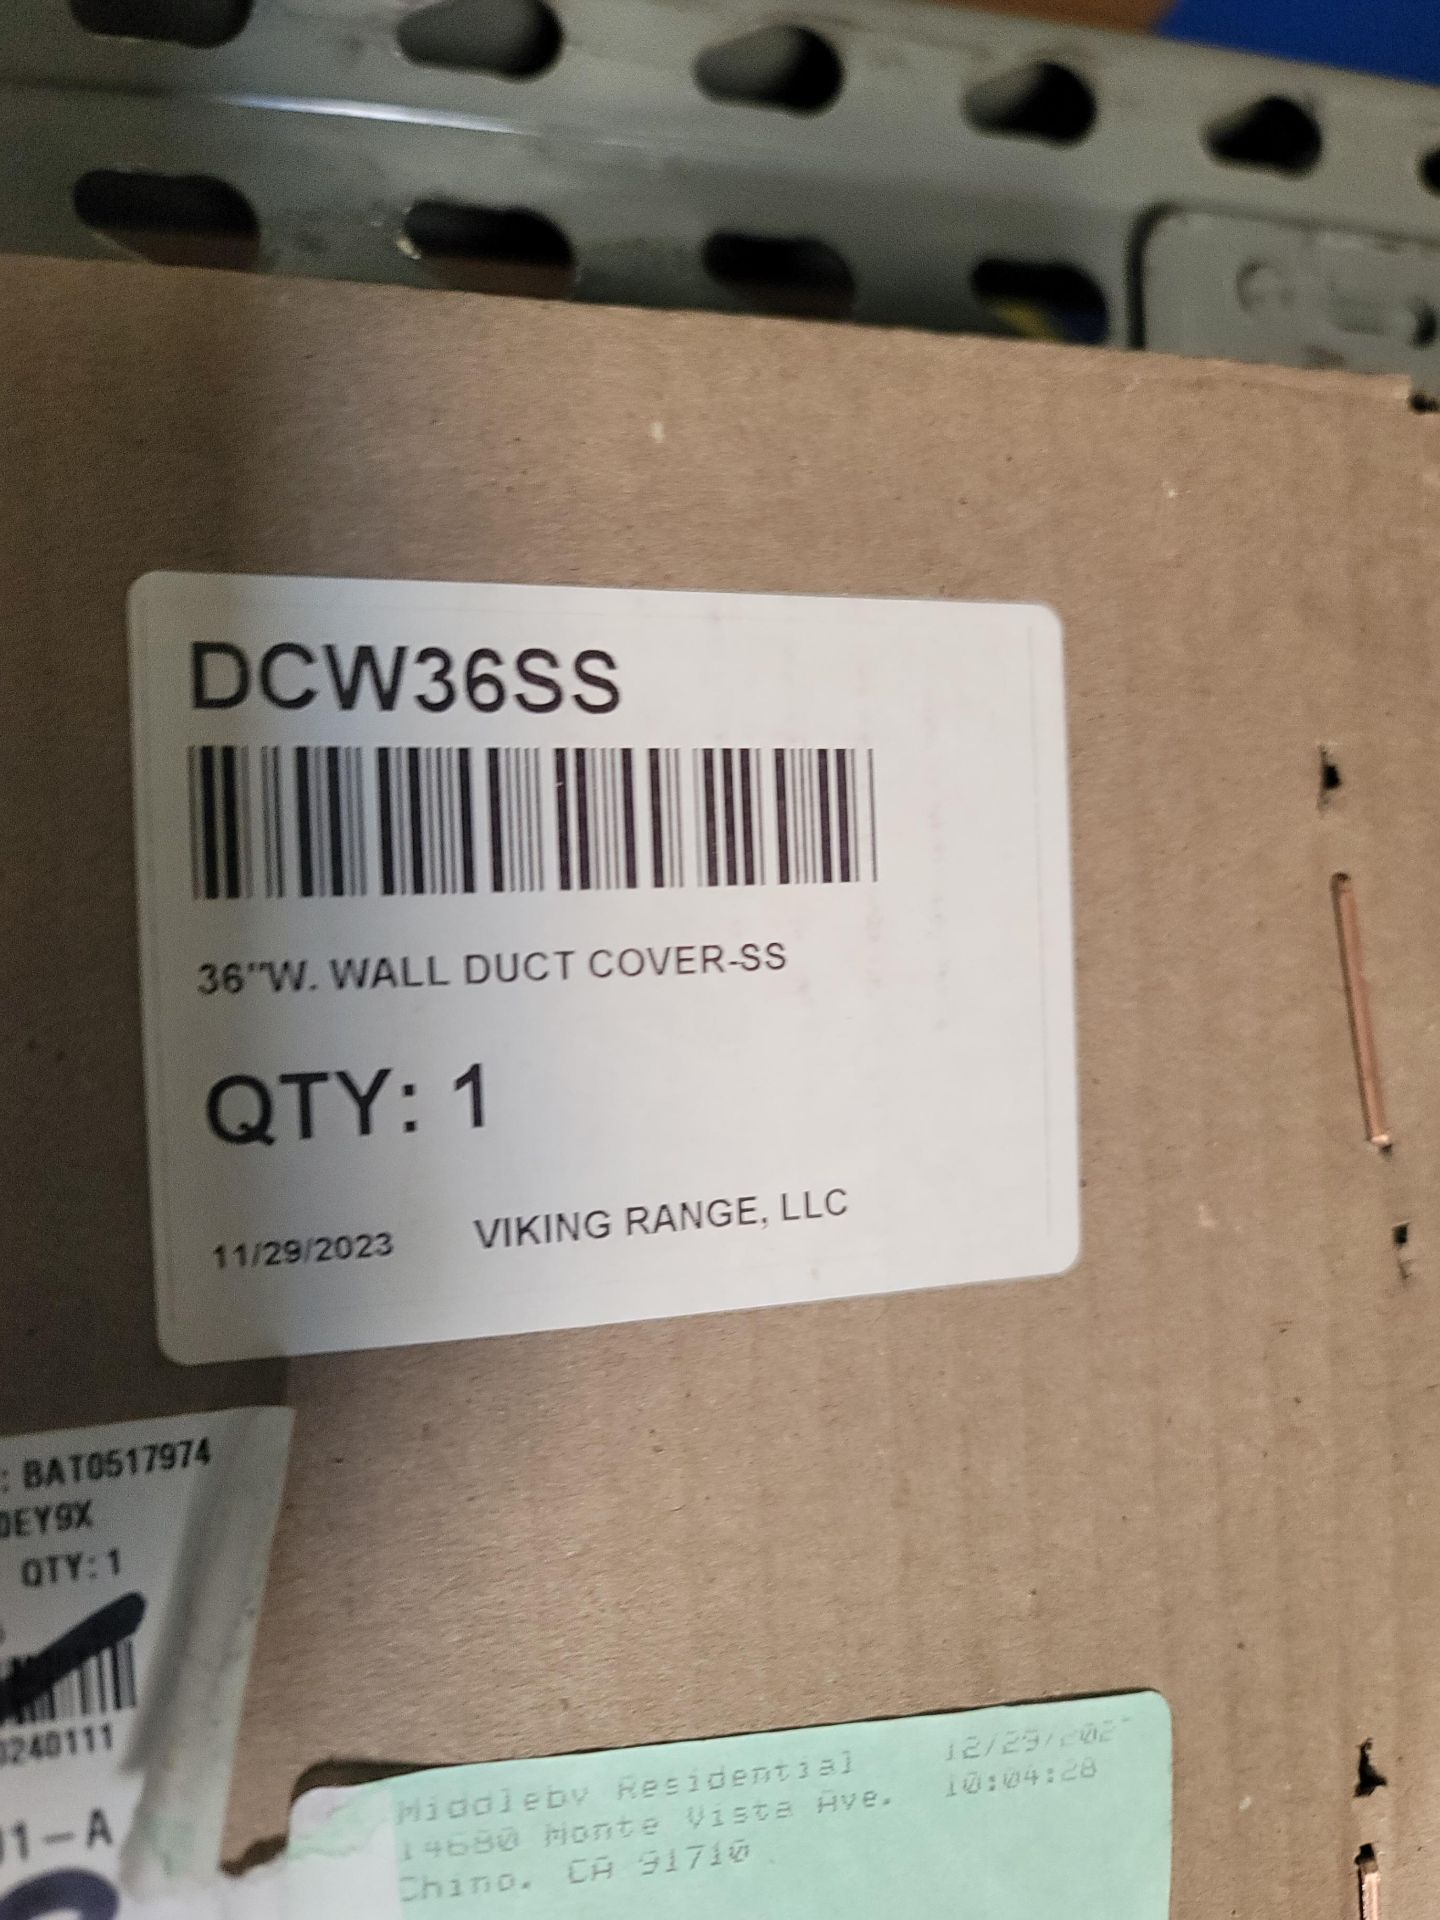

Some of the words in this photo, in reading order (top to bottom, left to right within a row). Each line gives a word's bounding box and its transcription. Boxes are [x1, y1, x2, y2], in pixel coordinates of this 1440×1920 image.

[191, 641, 621, 714] DCW36SS
[329, 956, 450, 989] WALL
[465, 950, 574, 985] DUCT
[588, 942, 787, 978] COVER-SS
[206, 1068, 416, 1146] QTY:
[455, 1062, 484, 1128] 1
[473, 1210, 612, 1249] VIKING
[626, 1196, 769, 1236] RANGE,
[780, 1187, 849, 1222] LLC
[213, 1232, 393, 1270] 11/29/2023
[24, 1437, 212, 1489] BAT0517974
[22, 1552, 98, 1588] QTY:
[109, 1548, 121, 1576] 1
[617, 1749, 853, 1800] Residential
[945, 1756, 1099, 1798] 10:04:28
[545, 1817, 659, 1849] Monte
[686, 1800, 794, 1829] Vista
[816, 1789, 891, 1815] Ave.
[568, 1856, 614, 1885] CA
[639, 1839, 750, 1878] 91710
